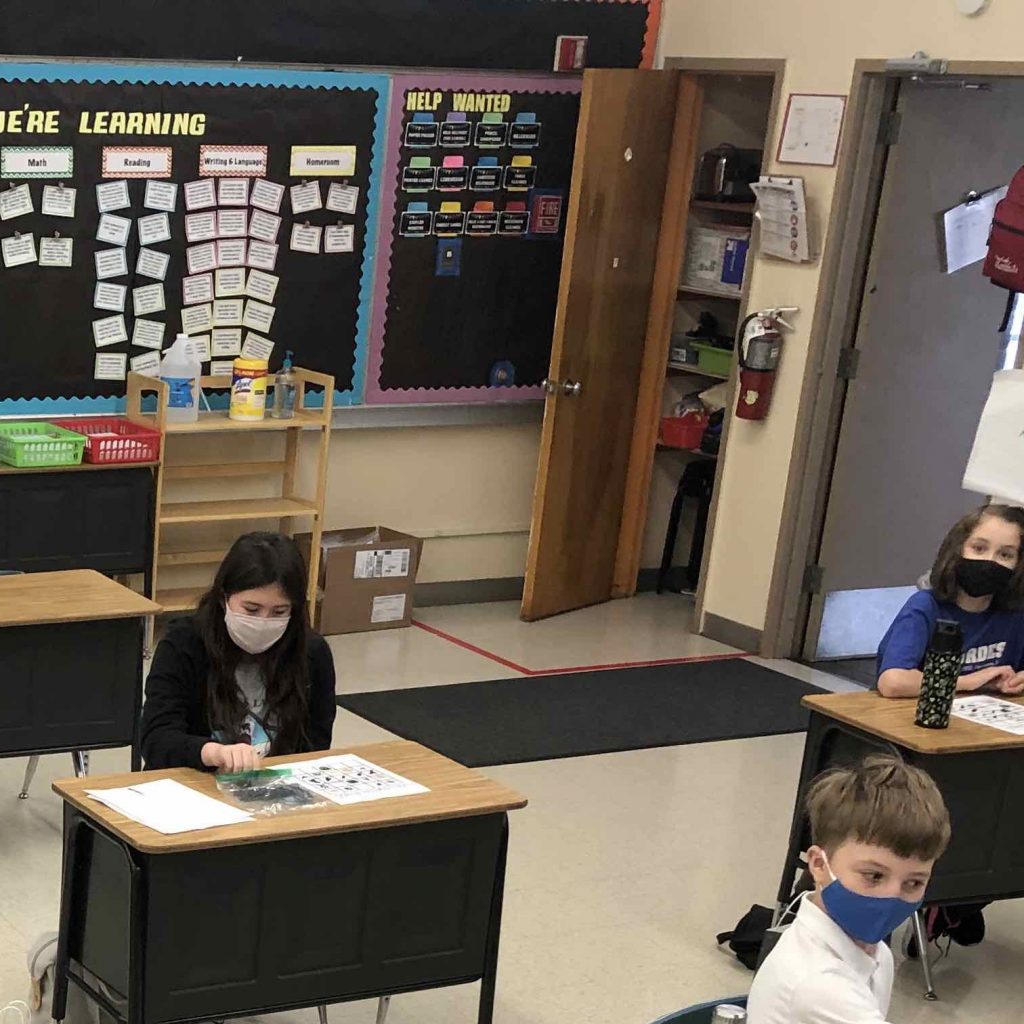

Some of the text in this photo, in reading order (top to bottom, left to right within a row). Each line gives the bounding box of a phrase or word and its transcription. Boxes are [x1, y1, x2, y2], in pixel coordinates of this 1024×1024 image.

[406, 91, 511, 113] HELP WANTED
[78, 111, 206, 136] LEARNING
[27, 158, 47, 168] Math
[123, 158, 151, 168] Reading
[204, 158, 226, 168] Writing
[234, 157, 263, 168] Language
[306, 158, 340, 167] Homeroom
